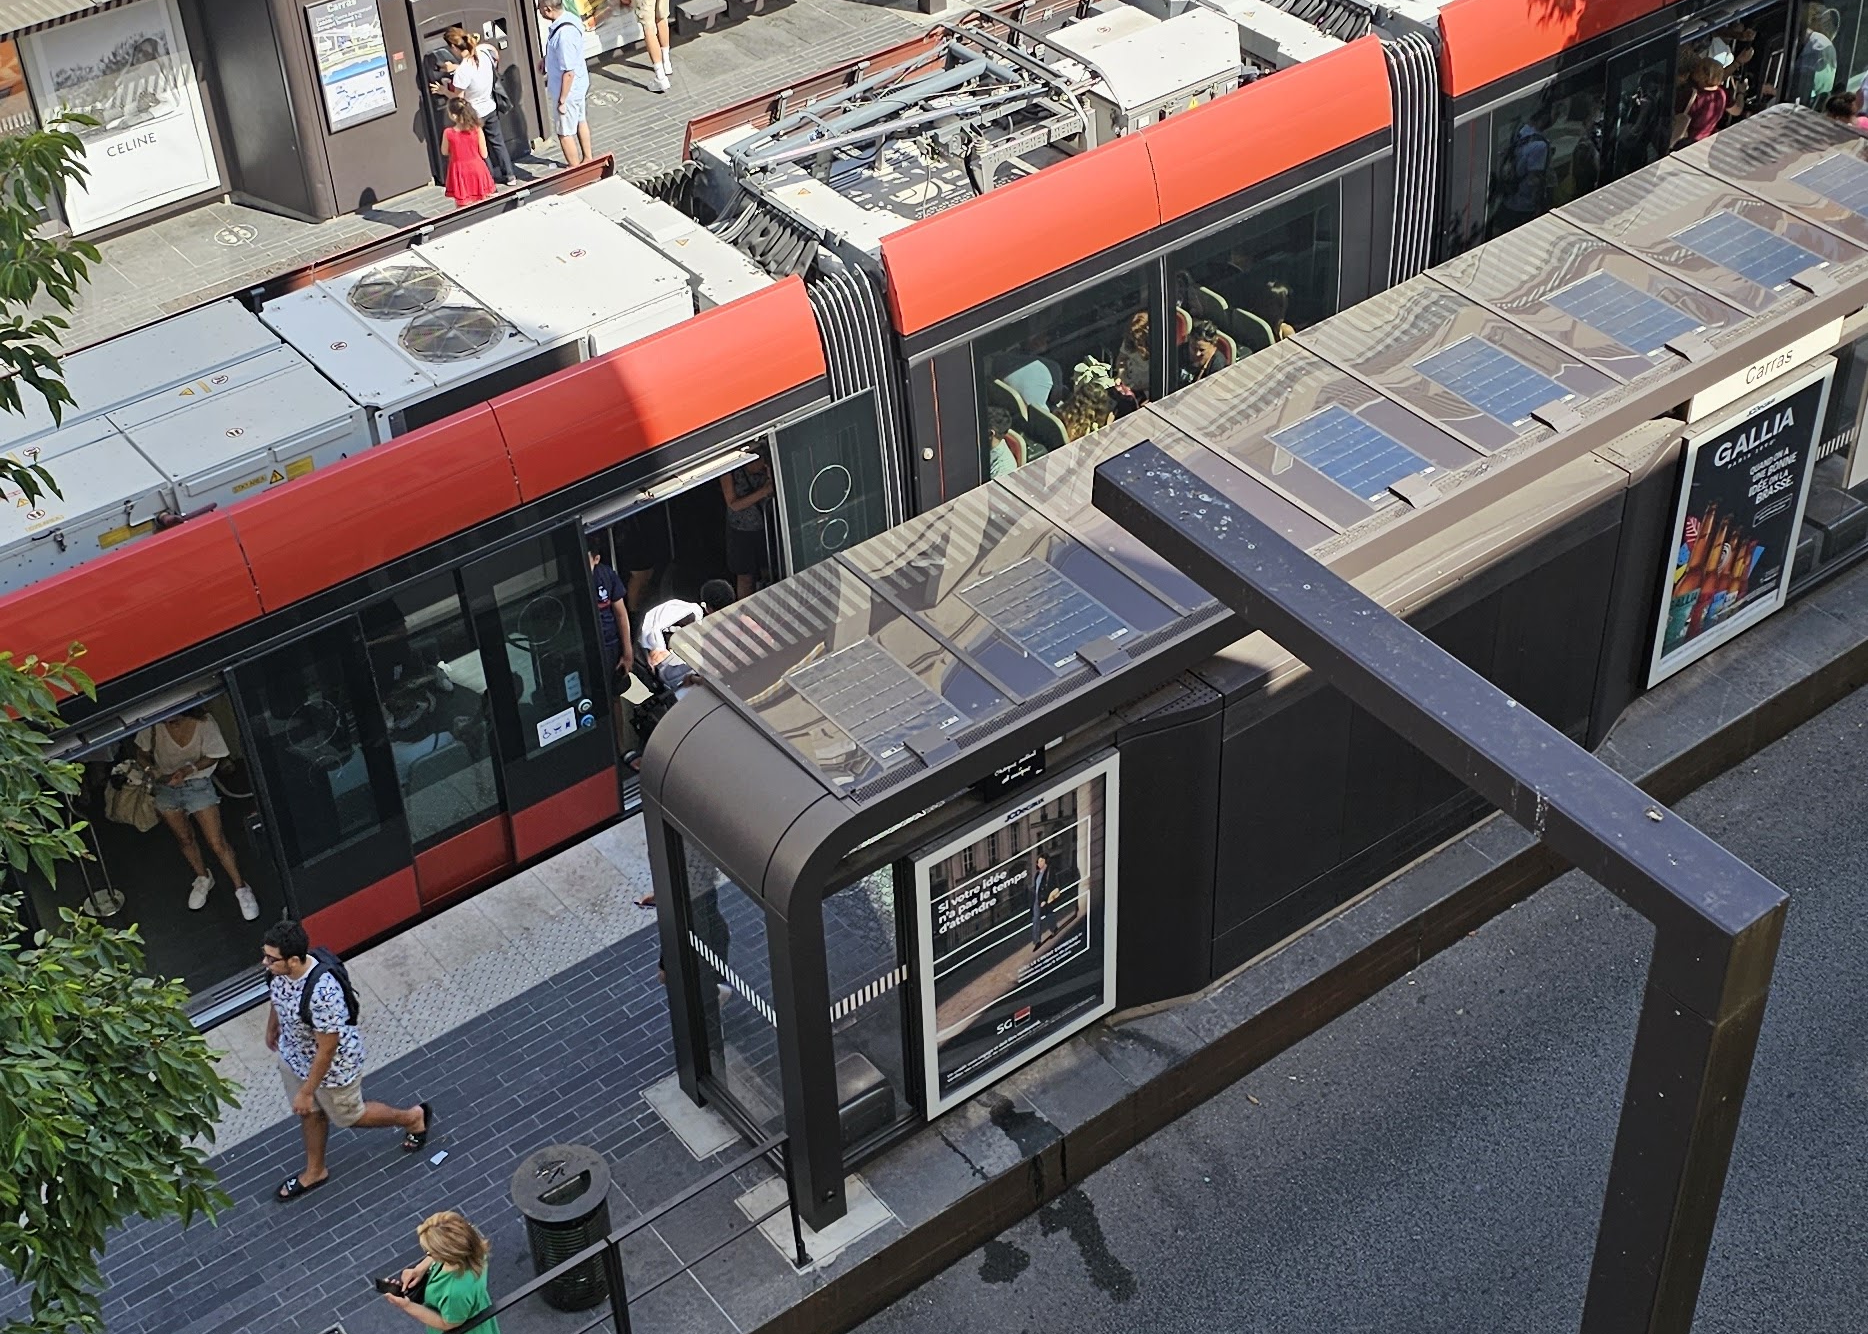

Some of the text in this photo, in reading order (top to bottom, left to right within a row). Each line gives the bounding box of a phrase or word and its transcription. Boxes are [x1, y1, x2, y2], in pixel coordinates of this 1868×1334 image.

[106, 132, 158, 158] CELINE
[1745, 349, 1794, 385] Carras
[1713, 406, 1795, 468] GALLIA
[938, 869, 1028, 925] n'a pas le temps
[950, 885, 981, 906] votre
[982, 870, 1008, 890] idée
[938, 897, 997, 935] d'attendre
[996, 1018, 1013, 1035] SG
